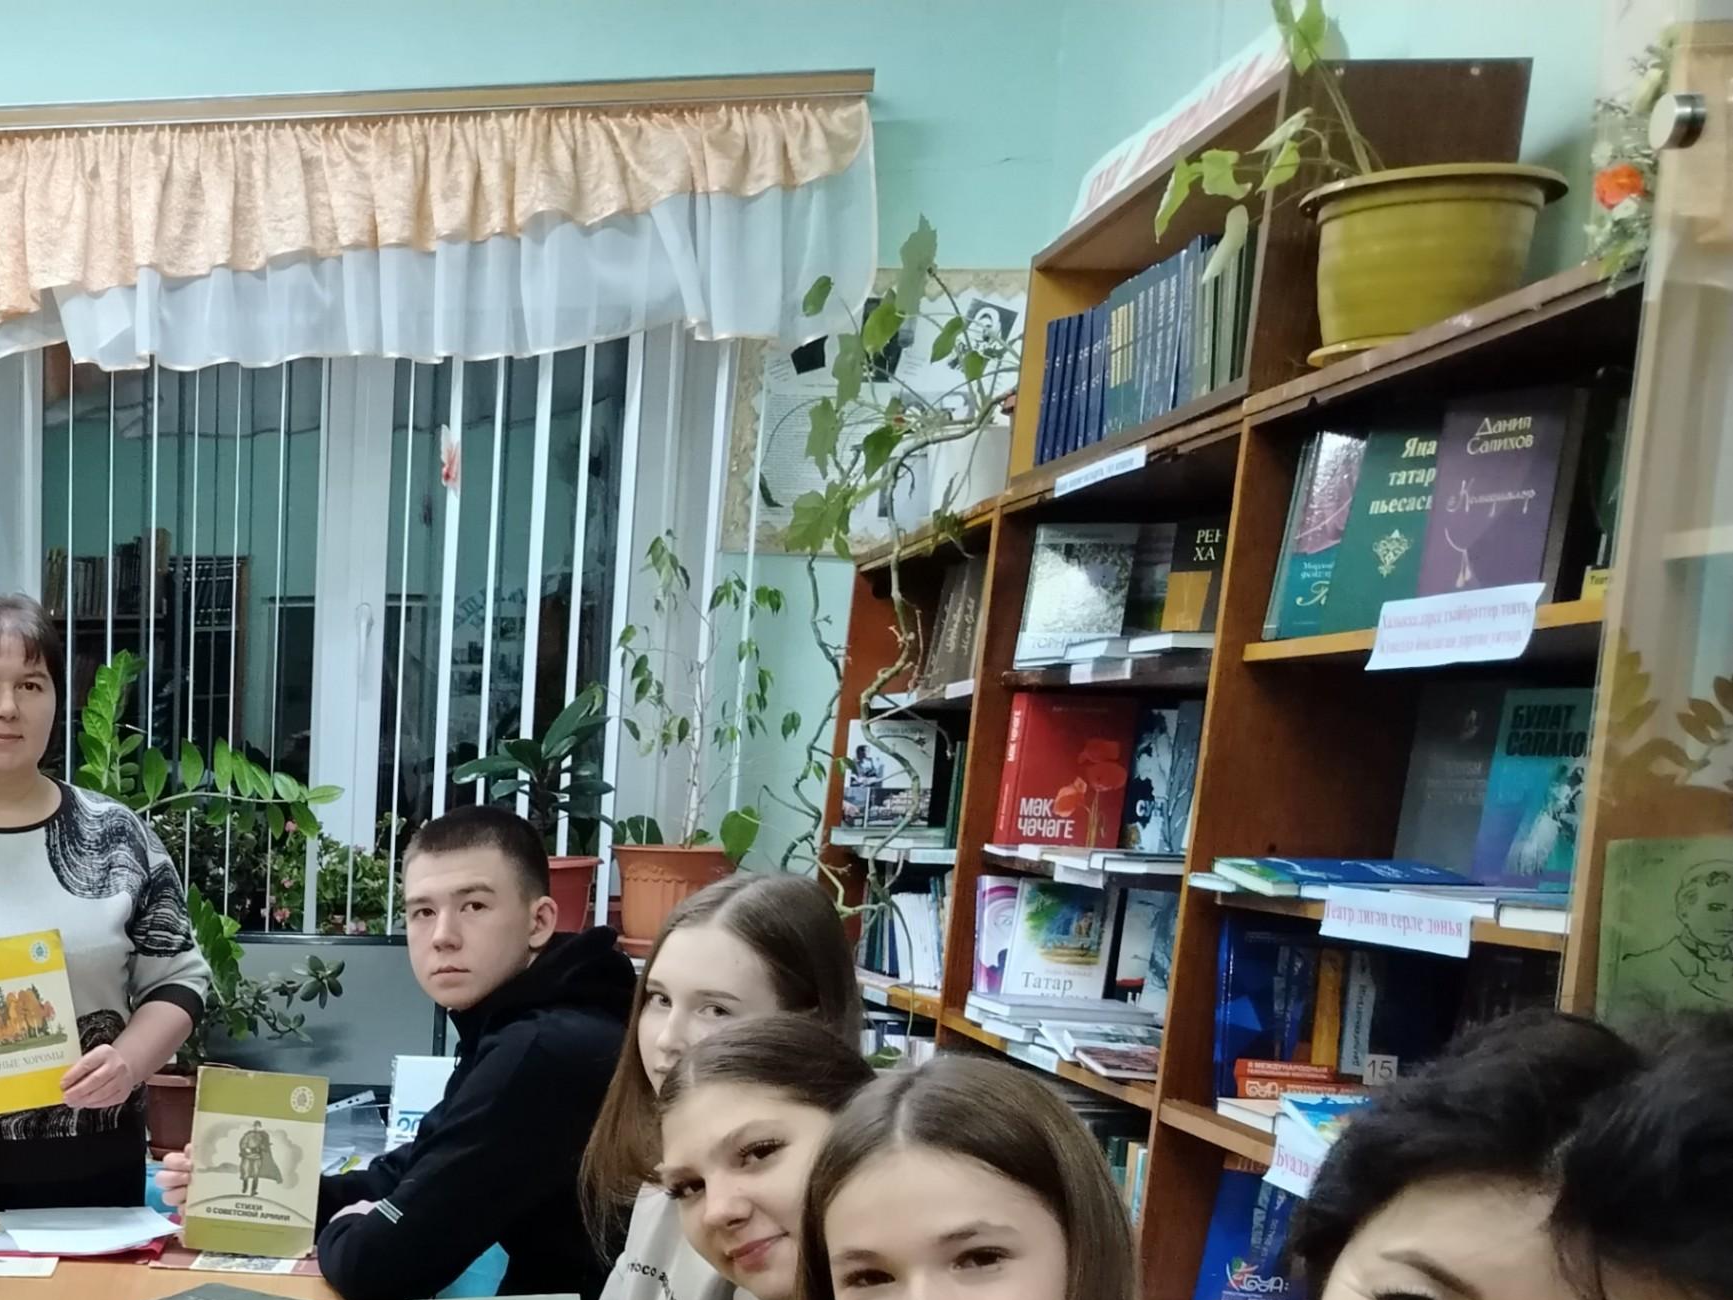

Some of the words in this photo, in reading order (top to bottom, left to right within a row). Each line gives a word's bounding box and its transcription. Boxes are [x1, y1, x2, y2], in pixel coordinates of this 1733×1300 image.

[1475, 415, 1533, 437] Данил
[1467, 434, 1534, 456] Салихов
[1388, 467, 1437, 487] татар
[1511, 704, 1576, 729] БУЛАТ
[1020, 796, 1055, 816] МӘК
[1018, 817, 1075, 838] ЧӘЧӘГЕ
[1358, 907, 1389, 928] дигән
[1391, 911, 1424, 936] серле
[1427, 914, 1463, 938] дөнья
[1021, 971, 1073, 991] Татар
[22, 1050, 65, 1068] ХОРОМЫ
[213, 1207, 259, 1219] СОВЕТСКОЙ
[260, 1212, 291, 1222] АРМИИ
[234, 1202, 263, 1212] СТИХИ
